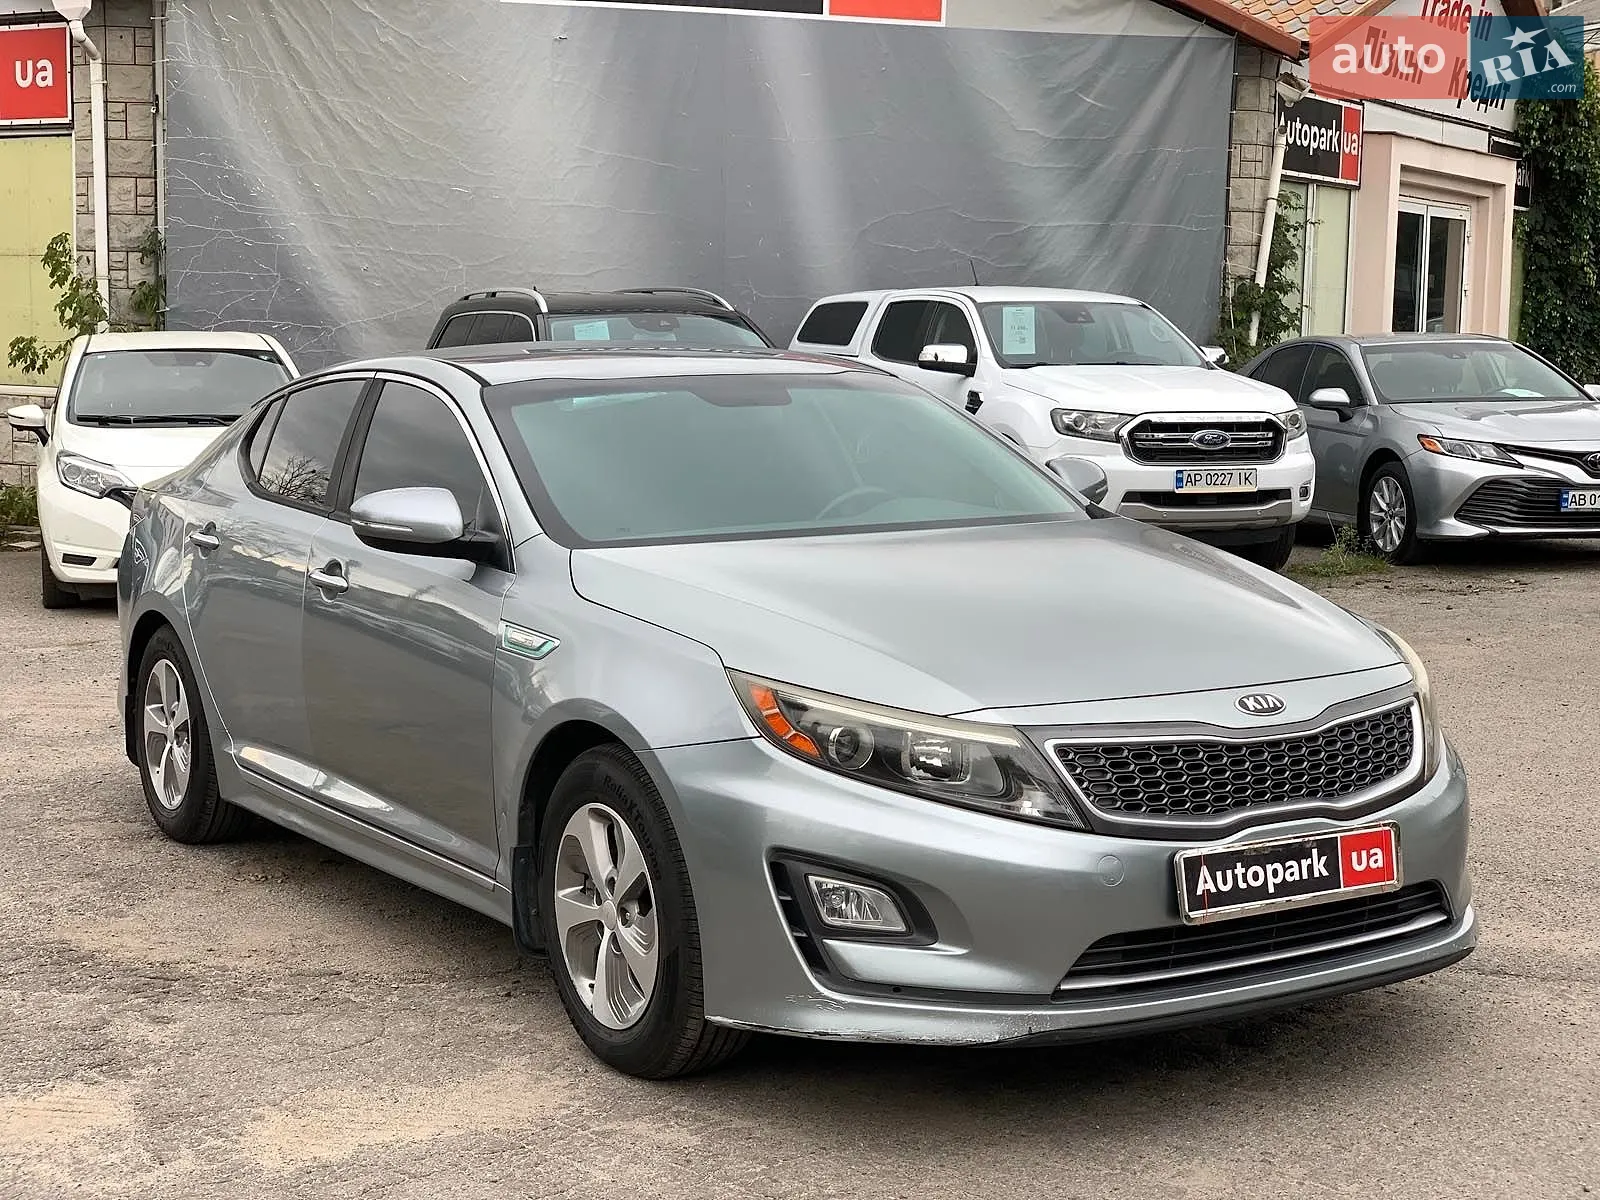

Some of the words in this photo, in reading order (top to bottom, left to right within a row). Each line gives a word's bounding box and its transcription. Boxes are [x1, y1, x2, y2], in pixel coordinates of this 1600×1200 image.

[1420, 0, 1473, 34] Trade
[1475, 0, 1493, 41] in
[15, 58, 54, 88] ua
[1448, 57, 1511, 114] Кредит
[1343, 131, 1358, 156] ua
[1202, 433, 1223, 445] Ford
[1185, 473, 1202, 487] AP
[1205, 472, 1233, 486] 0227
[1238, 472, 1253, 486] IK
[1569, 493, 1587, 507] AB
[1589, 493, 1600, 506] 0
[1242, 694, 1283, 712] KIA
[1196, 847, 1330, 896] Autopark
[1351, 846, 1384, 872] ua
